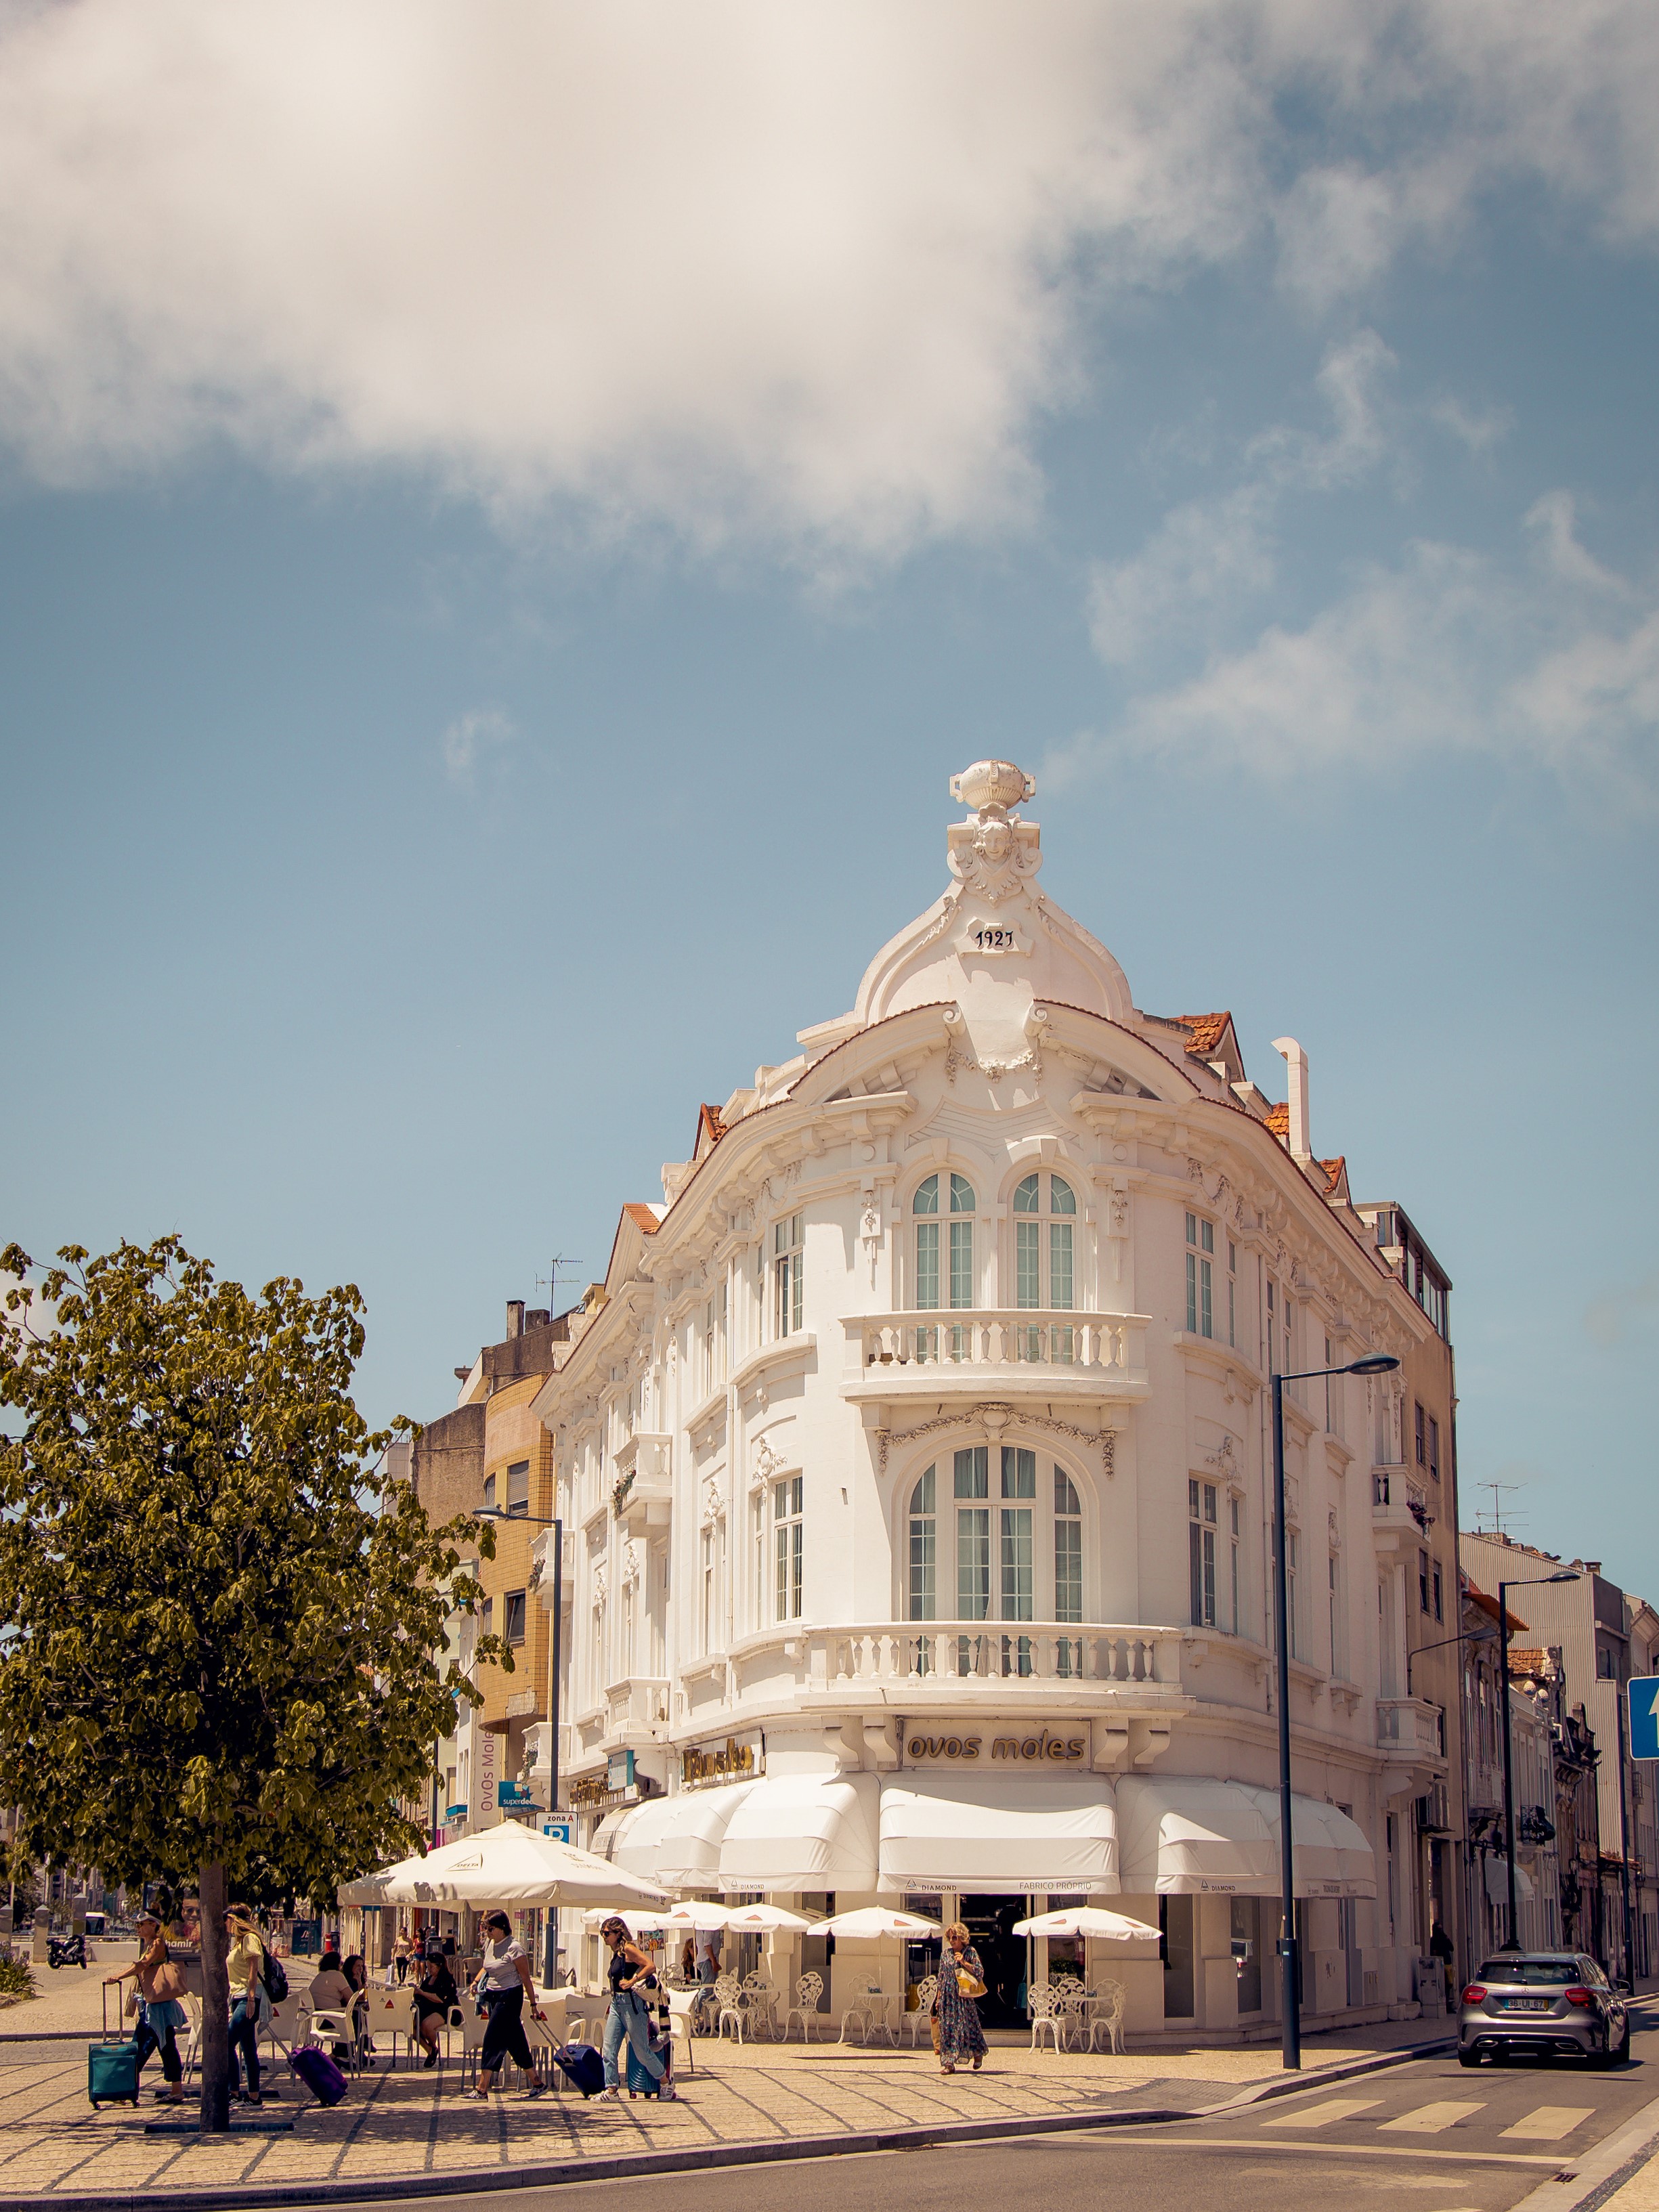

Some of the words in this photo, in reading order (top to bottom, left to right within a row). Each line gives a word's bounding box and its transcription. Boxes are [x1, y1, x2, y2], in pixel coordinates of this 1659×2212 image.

[975, 930, 1014, 947] 1927
[907, 1737, 982, 1758] ovos
[991, 1729, 1085, 1760] moles
[1019, 1882, 1054, 1890] FABRICO
[1056, 1880, 1092, 1890] PRÓPRIO
